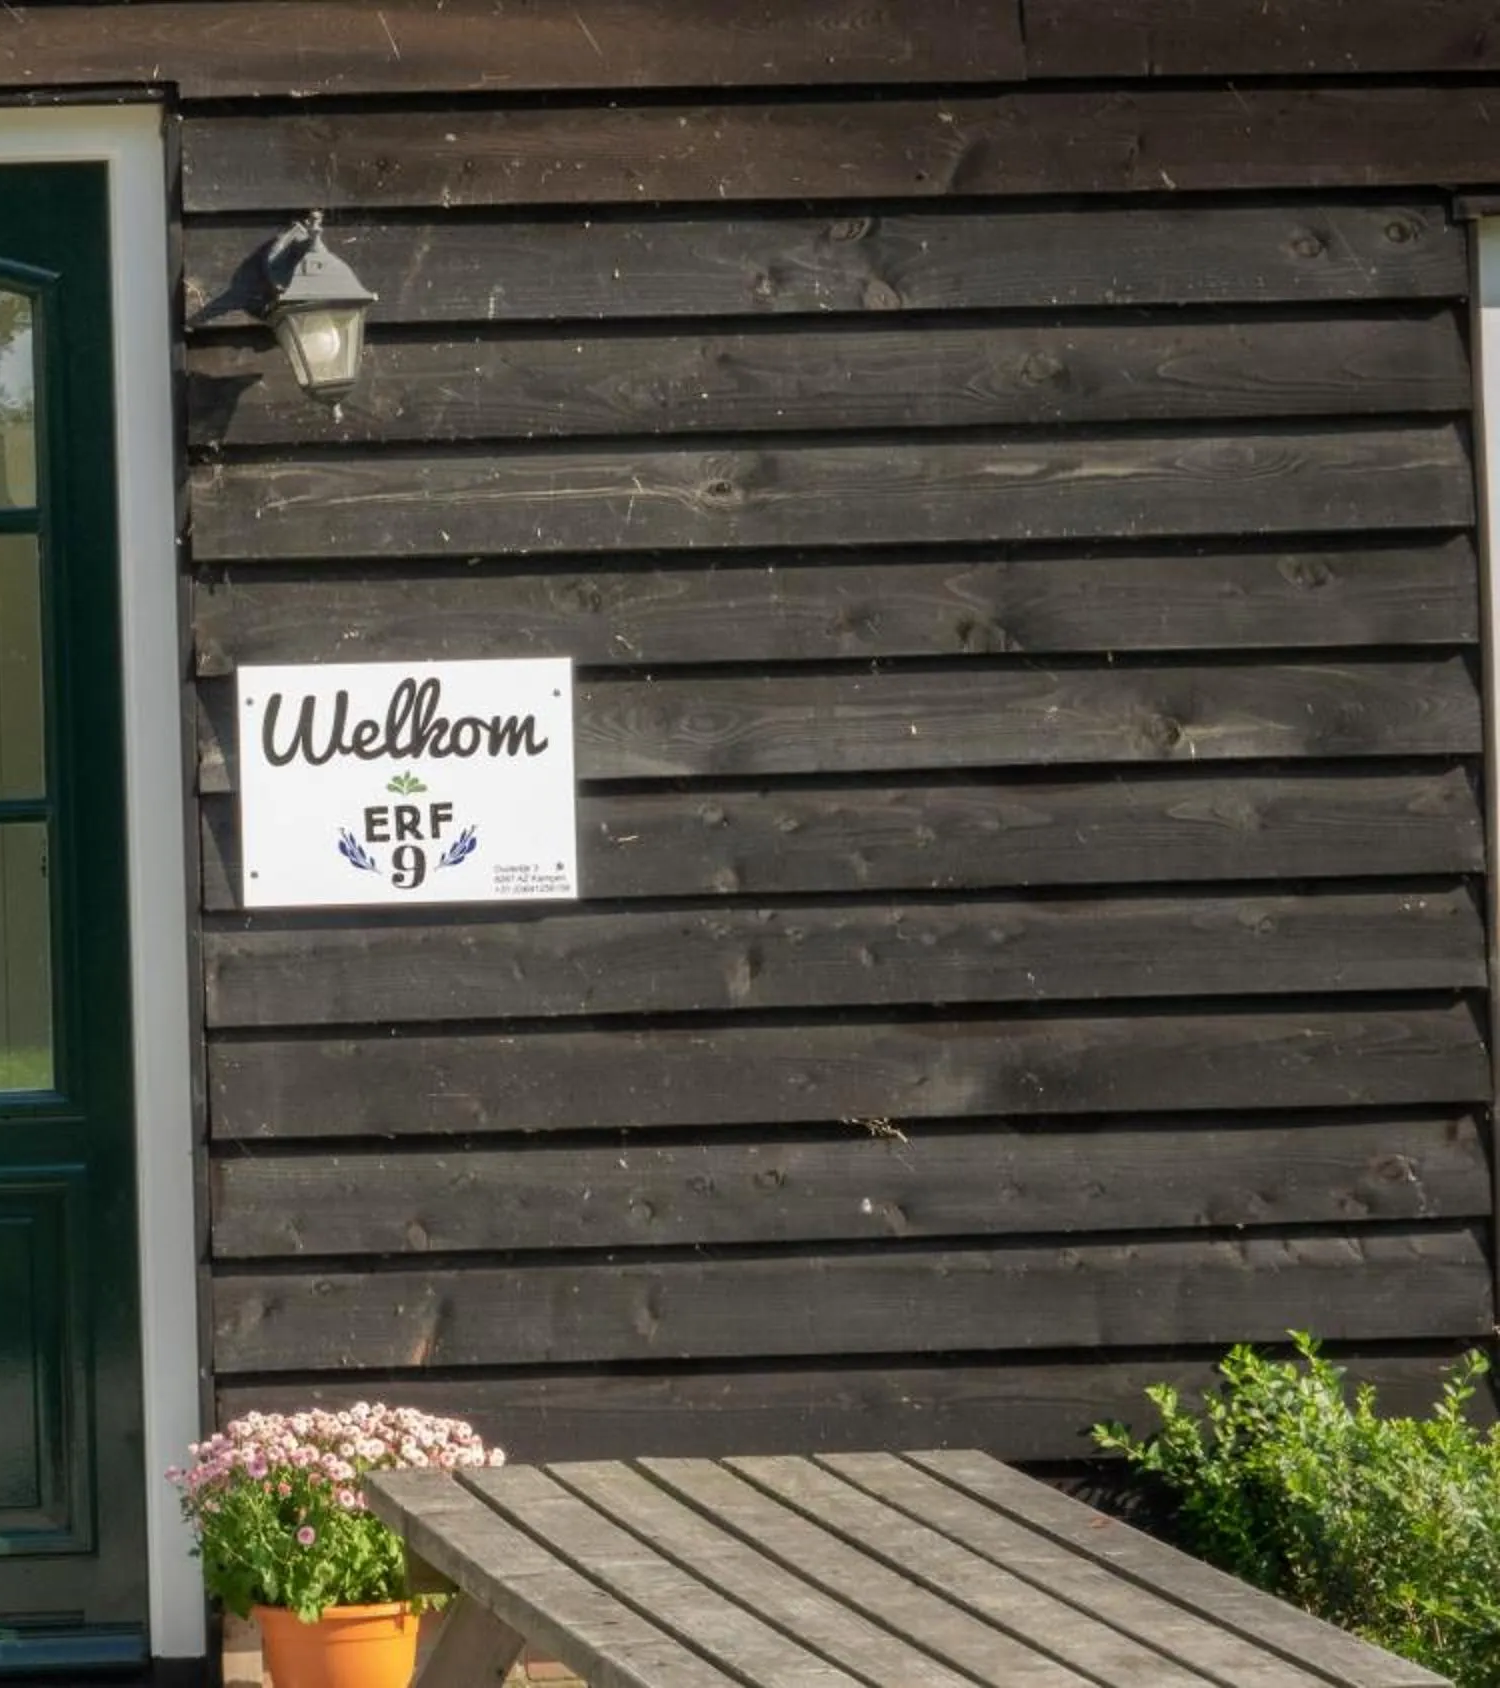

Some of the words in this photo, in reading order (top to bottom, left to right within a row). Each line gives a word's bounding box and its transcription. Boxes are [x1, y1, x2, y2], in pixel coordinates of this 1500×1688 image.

[262, 677, 549, 767] Welkom
[364, 802, 453, 843] ERF
[391, 845, 426, 889] 9
